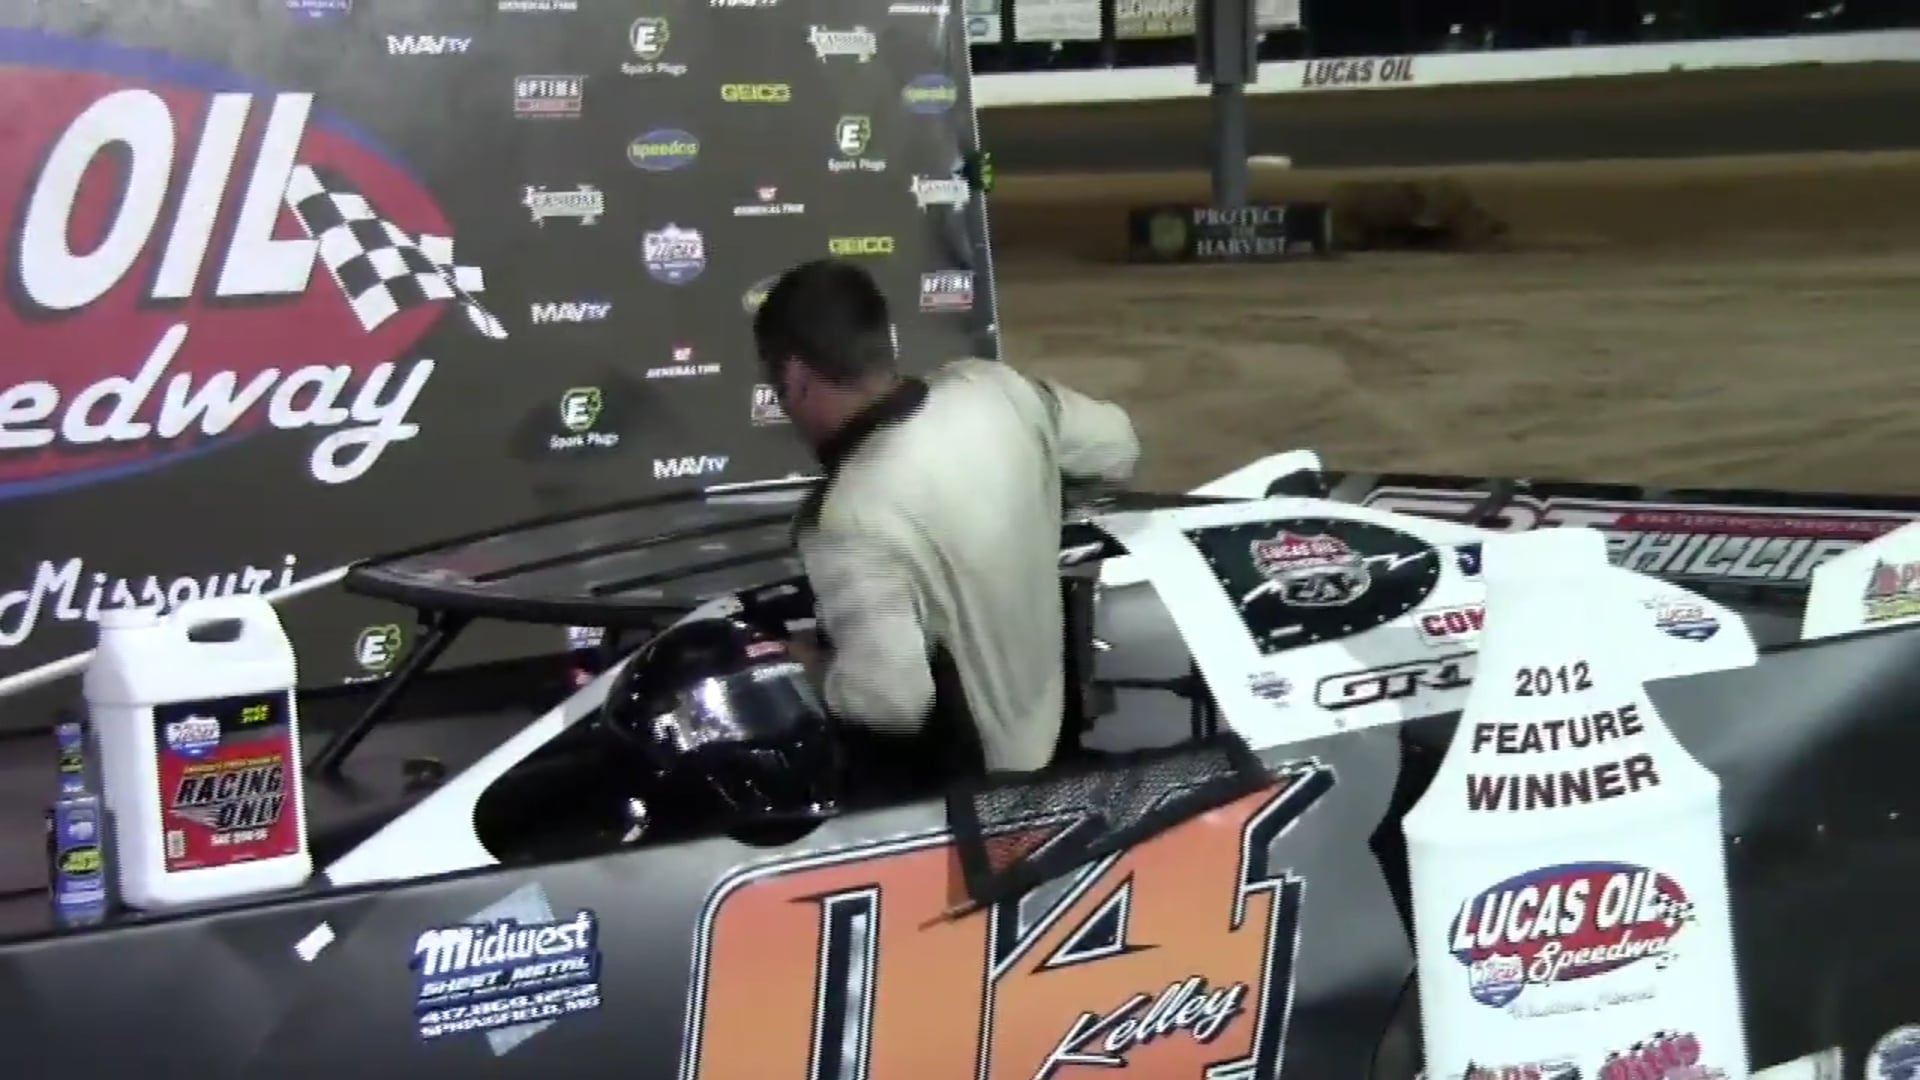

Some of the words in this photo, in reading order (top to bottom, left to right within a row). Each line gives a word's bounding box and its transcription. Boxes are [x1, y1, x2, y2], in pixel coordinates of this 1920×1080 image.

[621, 62, 653, 76] Spark
[656, 62, 688, 77] Plugs
[1302, 59, 1374, 87] LUCAS
[1380, 58, 1415, 83] OIL
[518, 79, 580, 97] OPTIMA
[721, 84, 791, 102] GEICO
[631, 140, 698, 160] speedco
[828, 158, 856, 171] Spark
[859, 158, 887, 171] Plugs
[19, 88, 319, 311] OIL
[1193, 207, 1287, 227] PROTECT
[829, 235, 896, 255] GEICO
[922, 276, 971, 294] OPTIMA
[646, 365, 696, 379] GENERAL
[550, 434, 584, 450] Spark
[587, 432, 619, 448] Plugs
[0, 554, 297, 647] Missouri
[1515, 659, 1594, 697] 2012
[1472, 702, 1644, 754] FEATURE
[175, 765, 284, 806] RACING
[1466, 752, 1660, 812] WINNER
[216, 794, 285, 830] ONLY
[1452, 878, 1592, 950] LUCAS
[1597, 869, 1660, 929] OIL
[415, 910, 590, 976] Midwest
[1529, 930, 1676, 982] Speedwa
[420, 970, 504, 998] SHEET
[508, 956, 590, 982] METAL
[1034, 975, 1250, 1080] Kelley
